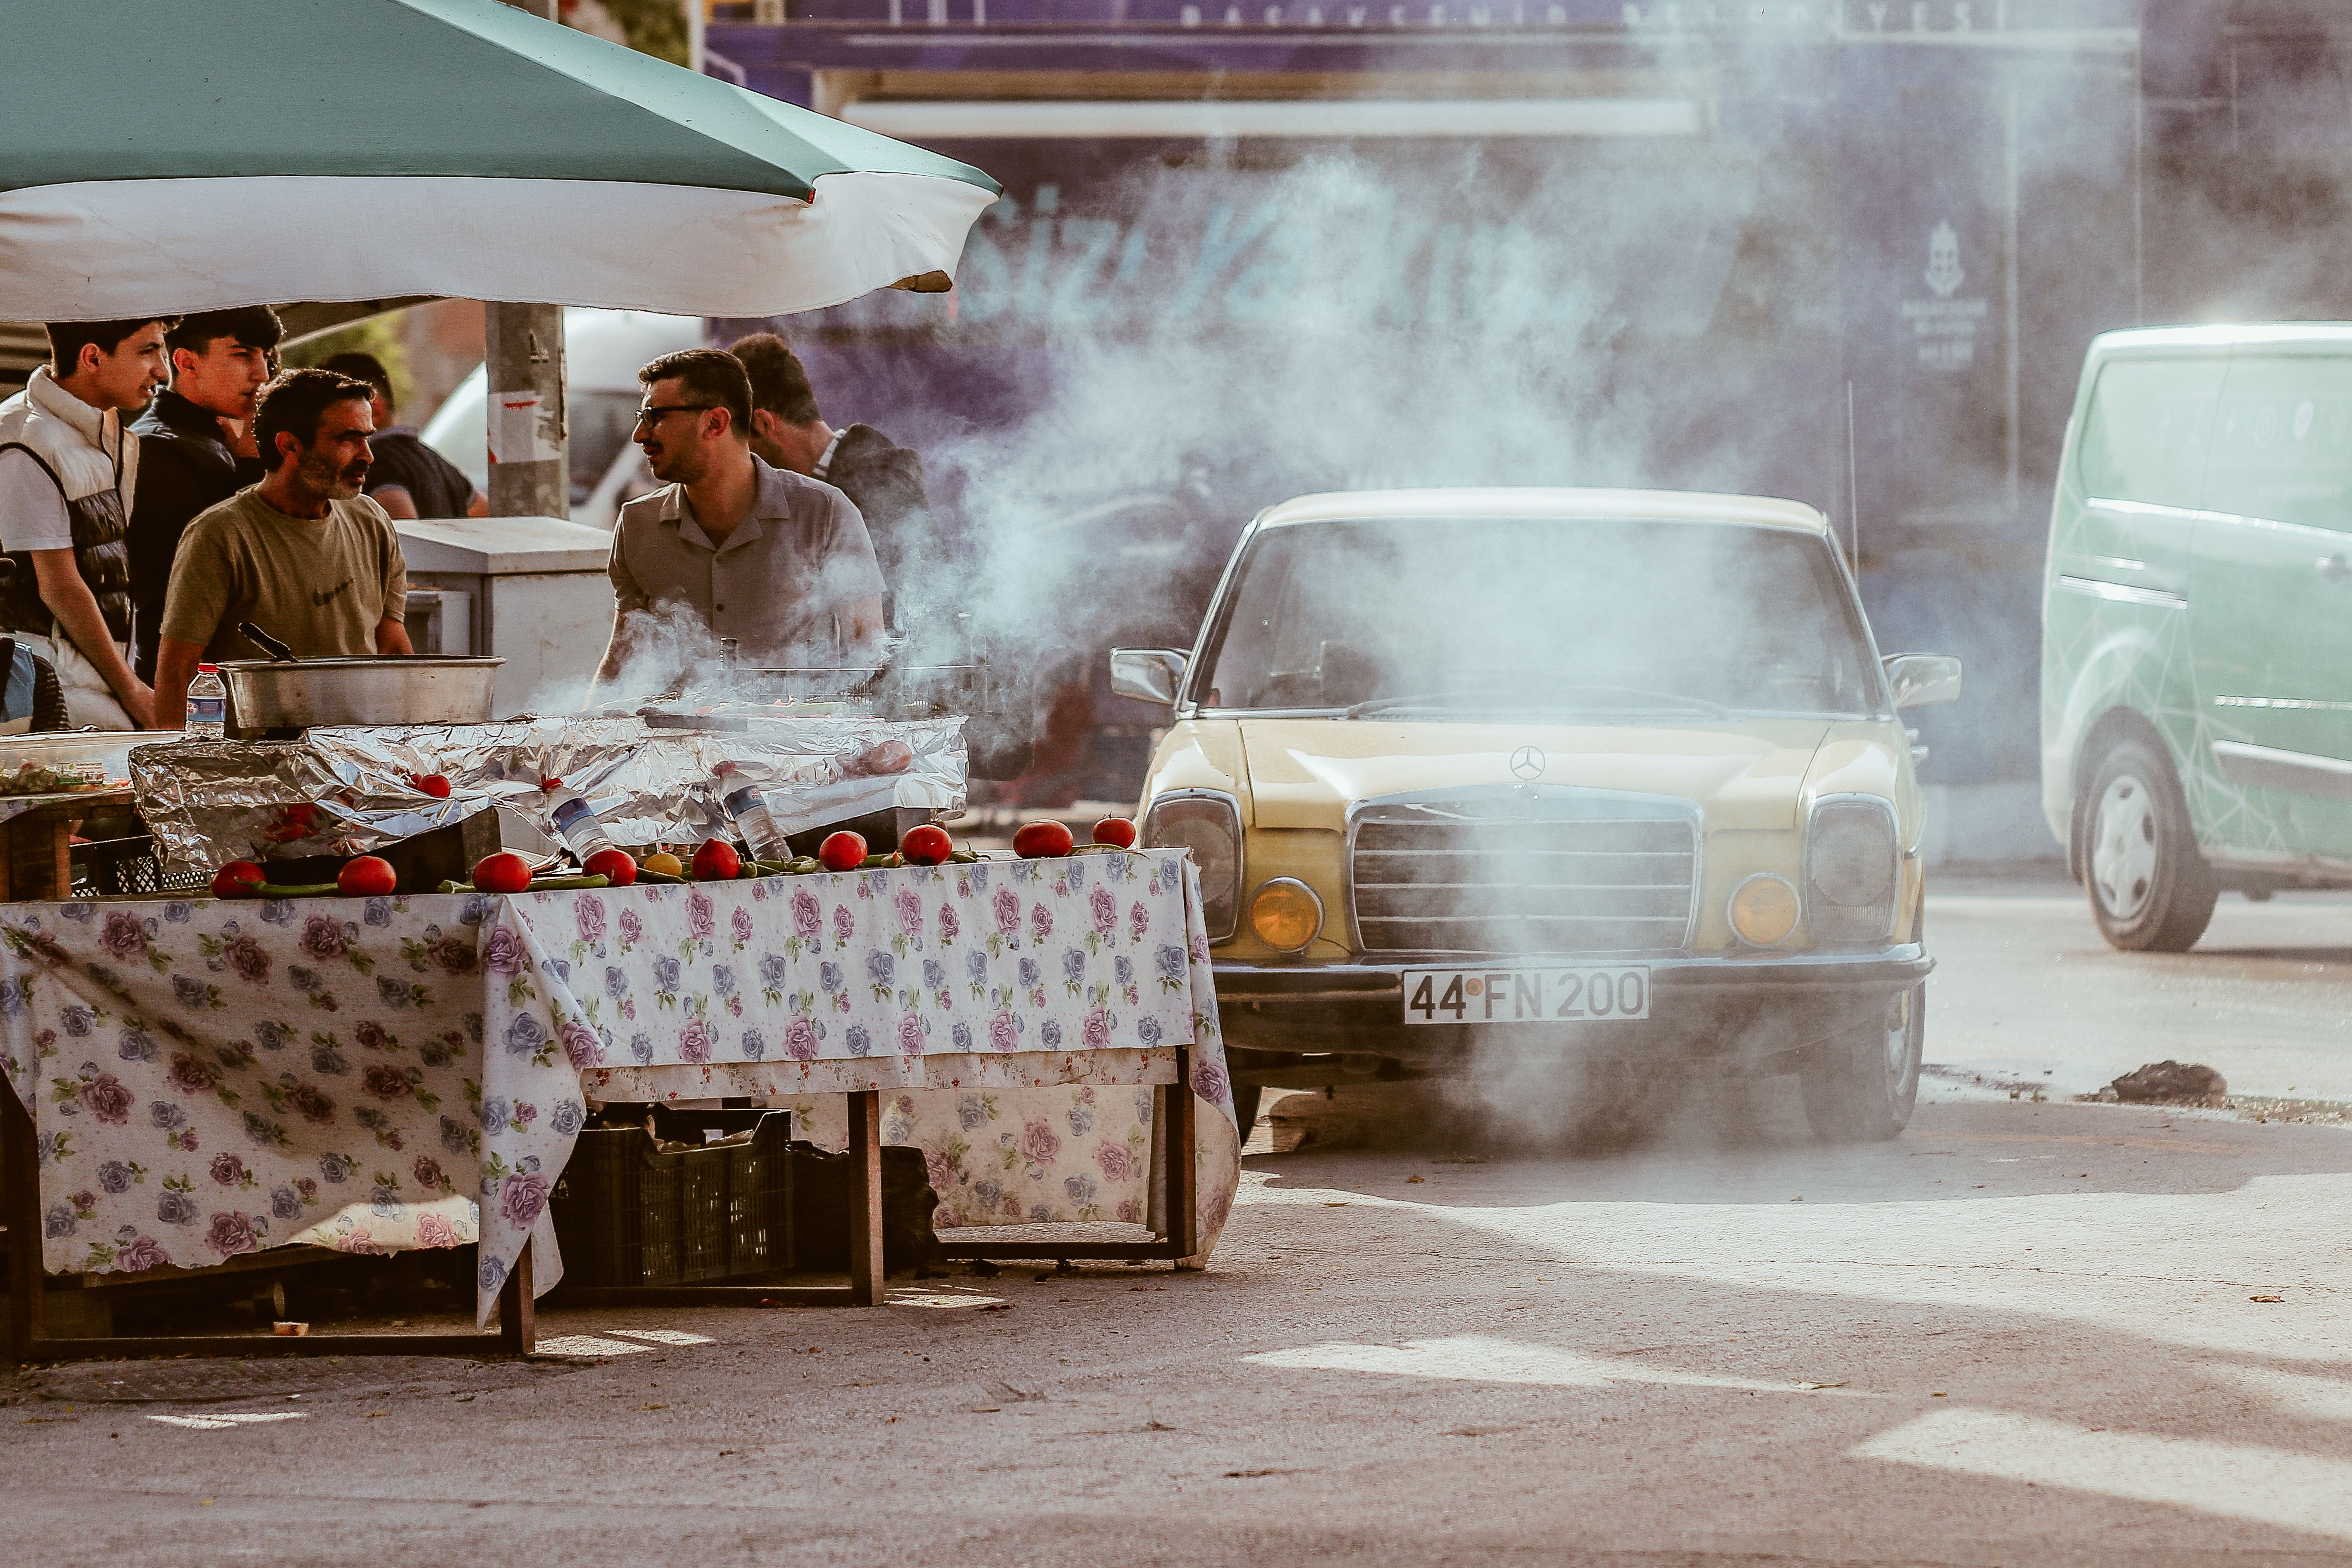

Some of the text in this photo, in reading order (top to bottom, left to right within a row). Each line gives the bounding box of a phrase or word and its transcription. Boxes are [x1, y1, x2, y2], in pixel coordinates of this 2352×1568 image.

[1410, 971, 1644, 1020] 44 FN 200
